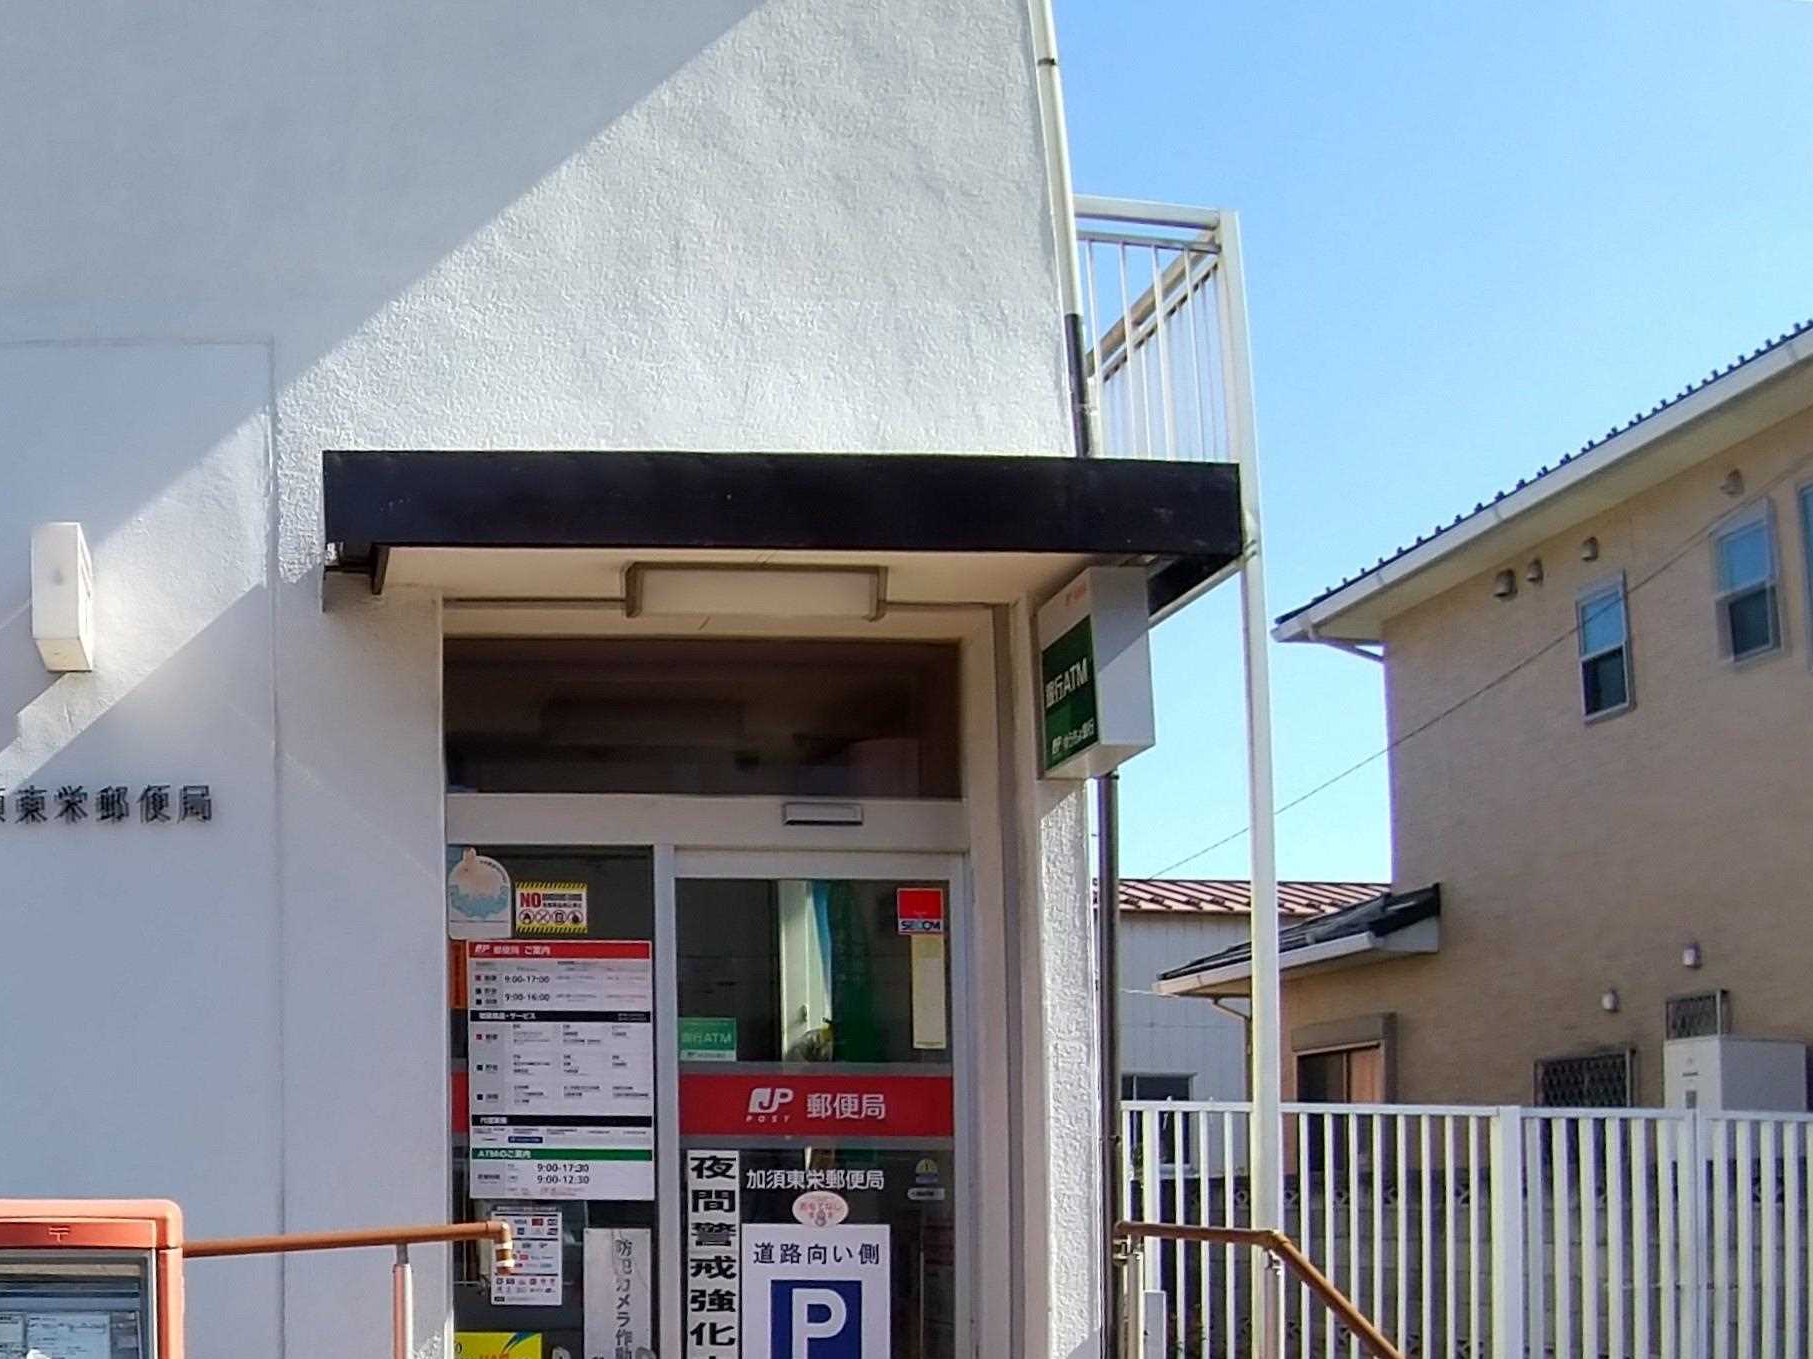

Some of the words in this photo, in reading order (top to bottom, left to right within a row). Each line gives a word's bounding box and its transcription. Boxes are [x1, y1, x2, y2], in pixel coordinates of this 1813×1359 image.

[520, 892, 541, 908] NO
[504, 975, 550, 984] 9:00-17:00
[807, 1094, 886, 1119] 郵便局
[746, 1115, 791, 1123] POST
[537, 1163, 590, 1173] 9:00-17:30
[537, 1175, 590, 1184] 9:00-12:30
[746, 1169, 885, 1189] 加須東栄郵便局
[753, 1243, 880, 1264] 道路向い側
